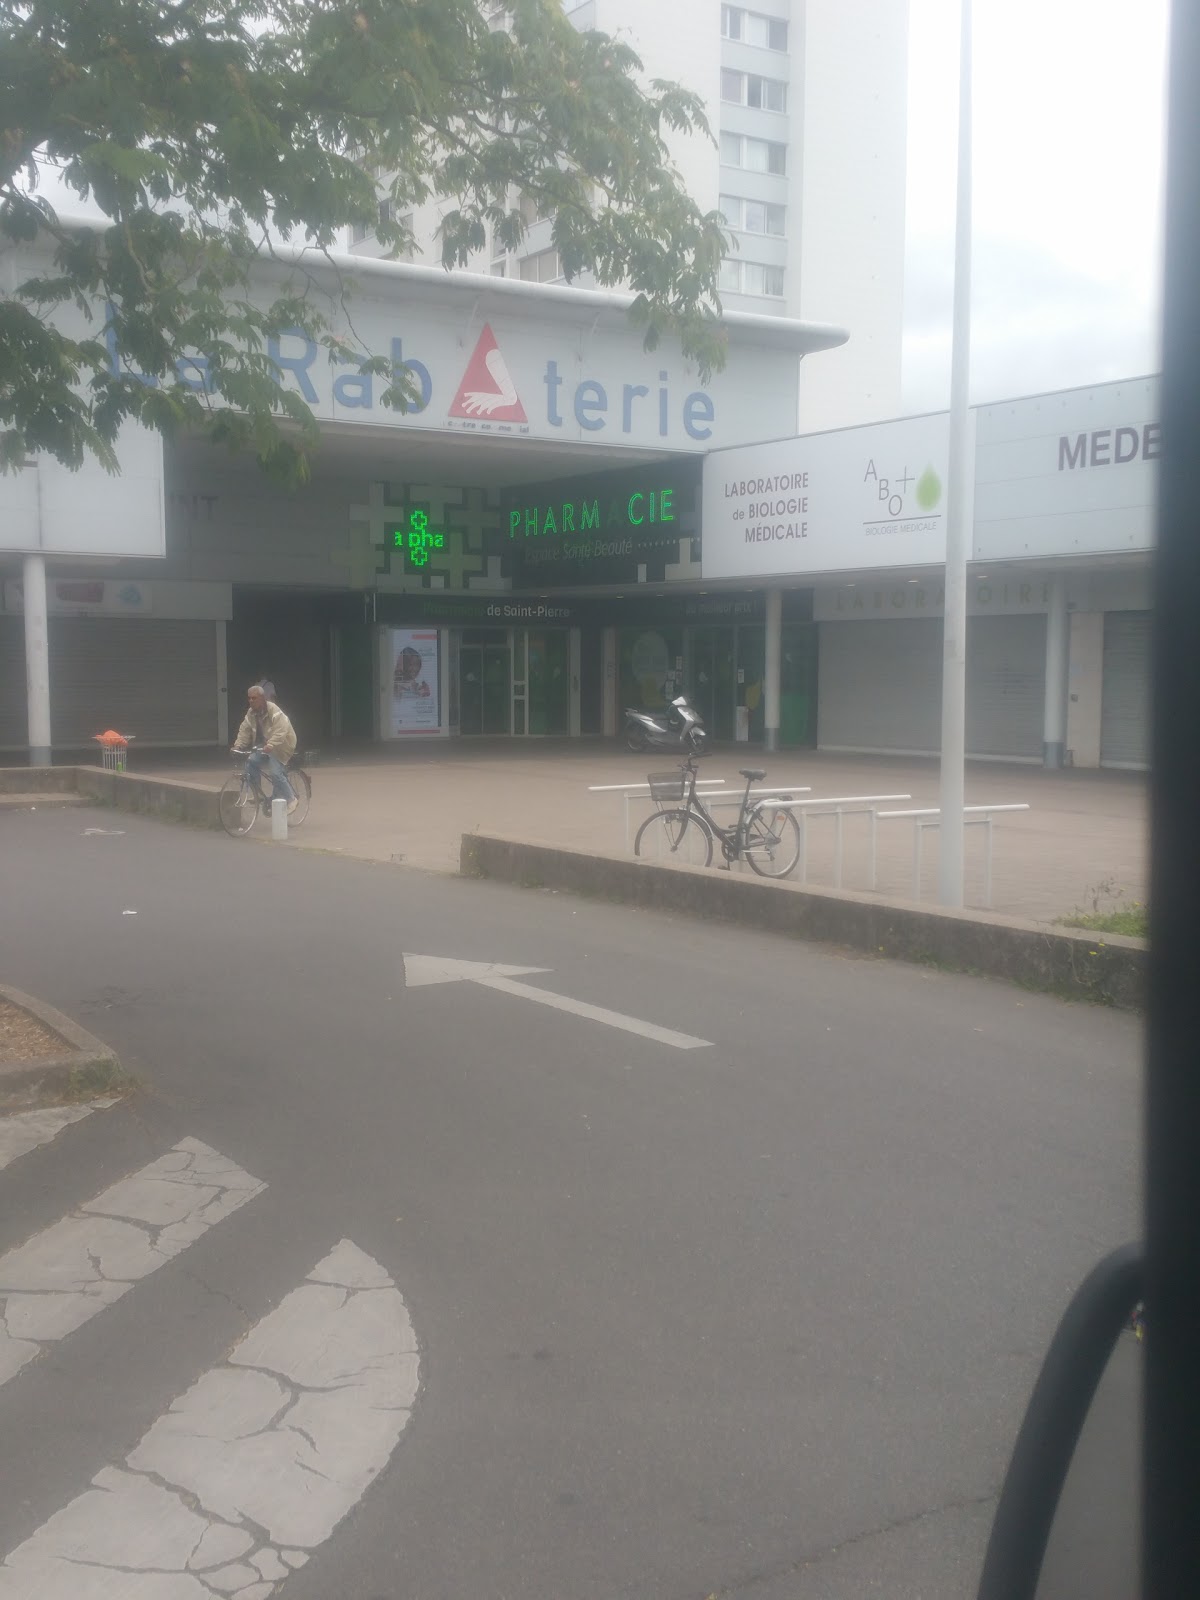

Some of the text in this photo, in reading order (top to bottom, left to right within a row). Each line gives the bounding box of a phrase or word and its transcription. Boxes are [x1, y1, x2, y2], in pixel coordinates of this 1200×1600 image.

[724, 472, 809, 498] LABORATOIRE
[732, 497, 809, 521] de BIOLOGIE
[744, 522, 808, 543] MÉDICALE
[865, 525, 899, 537] BIOLOGIE
[594, 537, 632, 558] Beauté
[487, 604, 501, 617] de
[503, 605, 571, 618] Saint-Pierre
